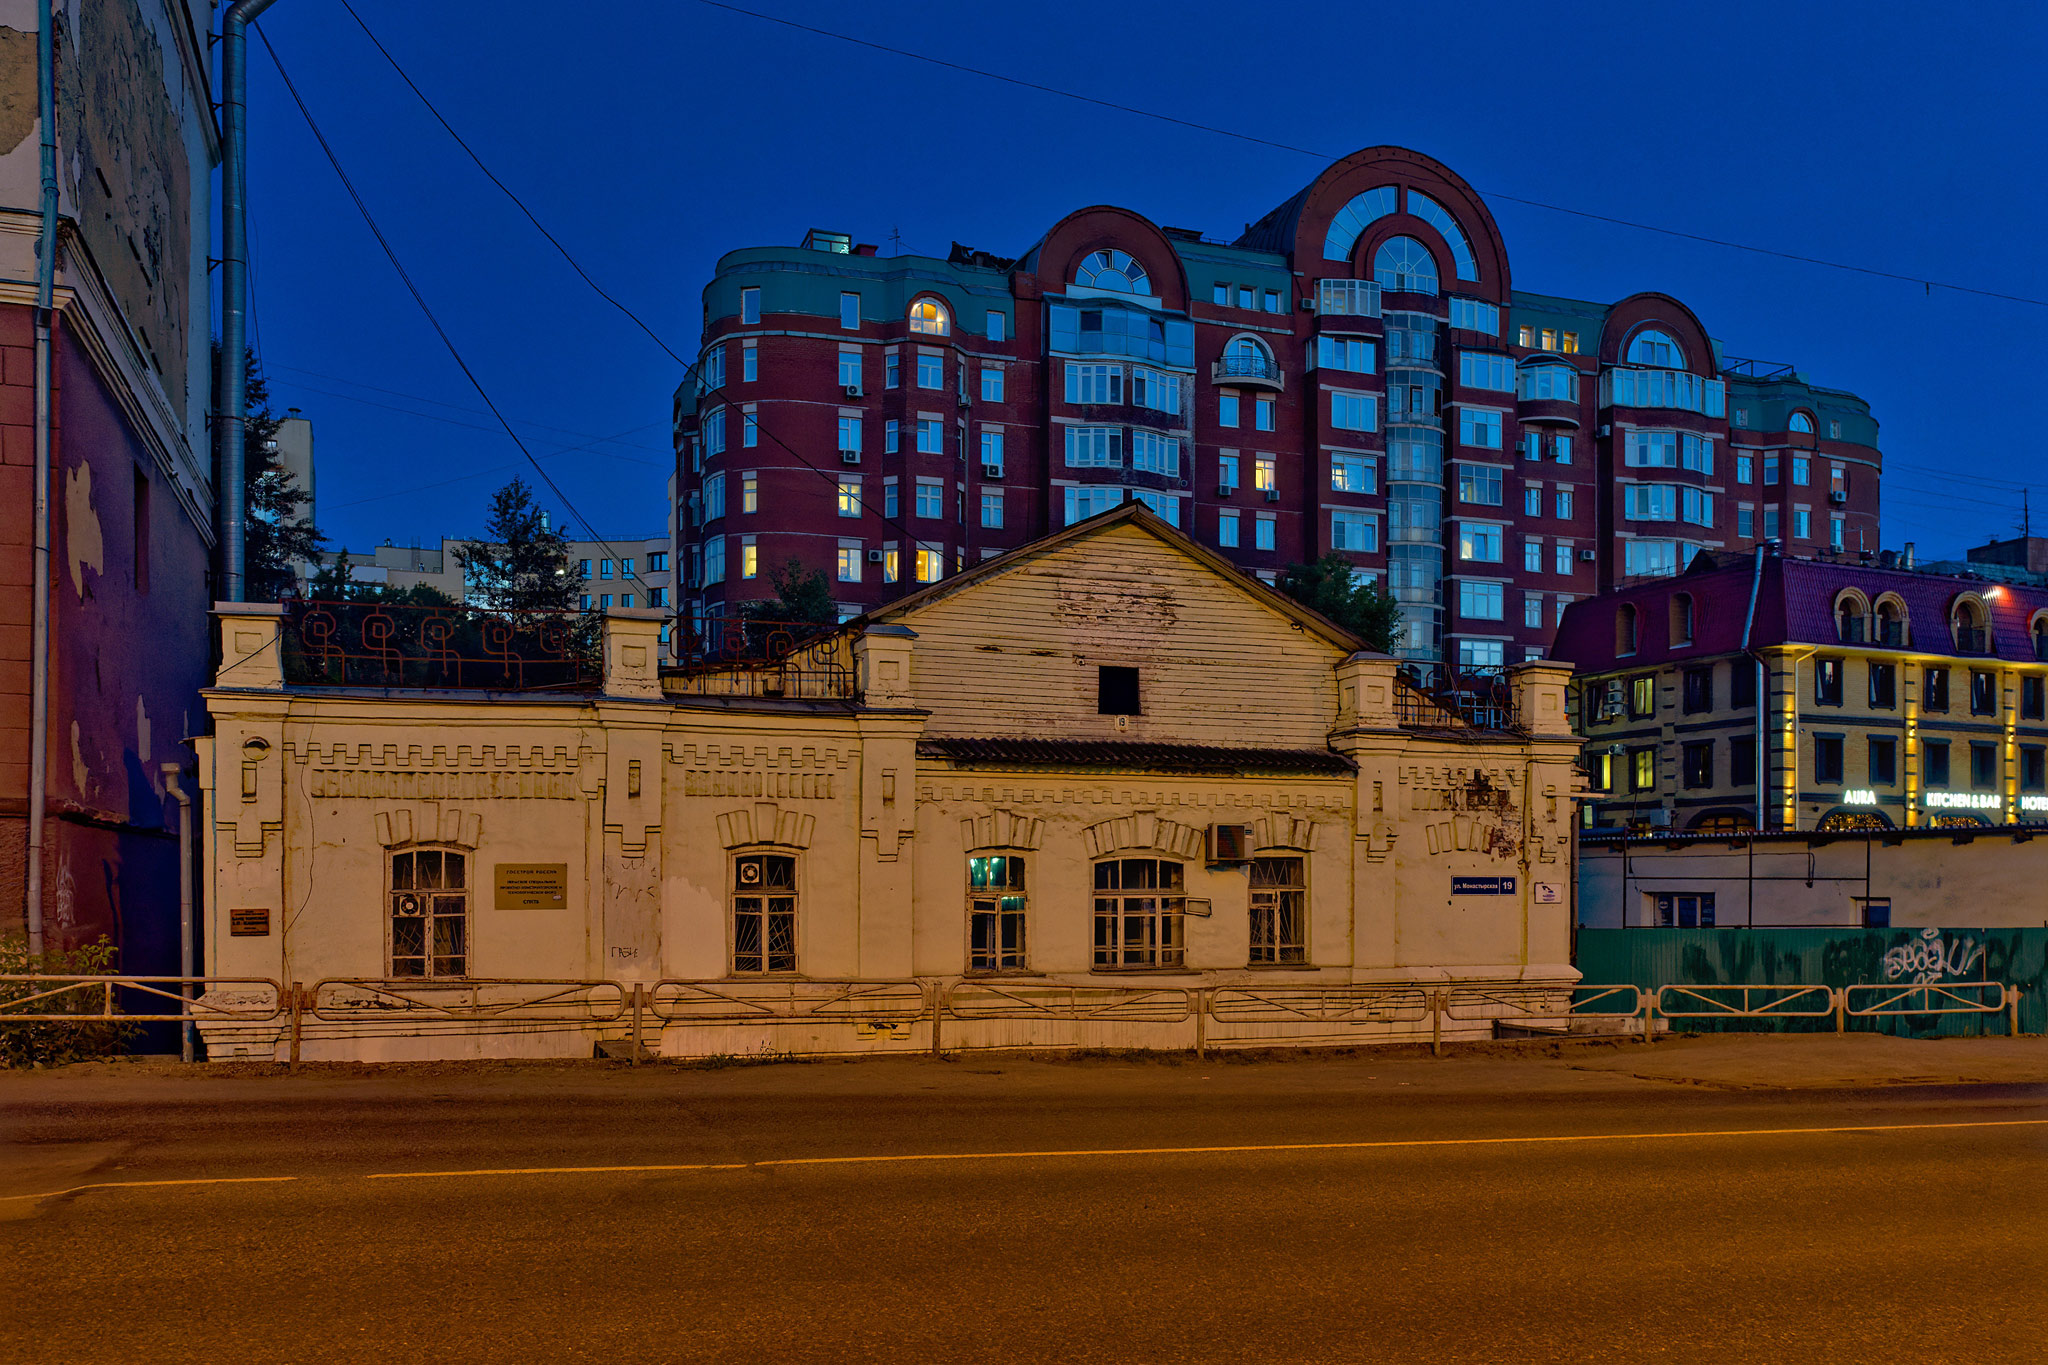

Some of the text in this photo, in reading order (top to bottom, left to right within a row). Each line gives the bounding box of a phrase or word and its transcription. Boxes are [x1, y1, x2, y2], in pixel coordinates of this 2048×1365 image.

[1843, 789, 1877, 805] AURA
[1926, 792, 2001, 809] KITCHEN & BAR
[1462, 882, 1498, 890] Монастырская
[1502, 881, 1513, 890] 19
